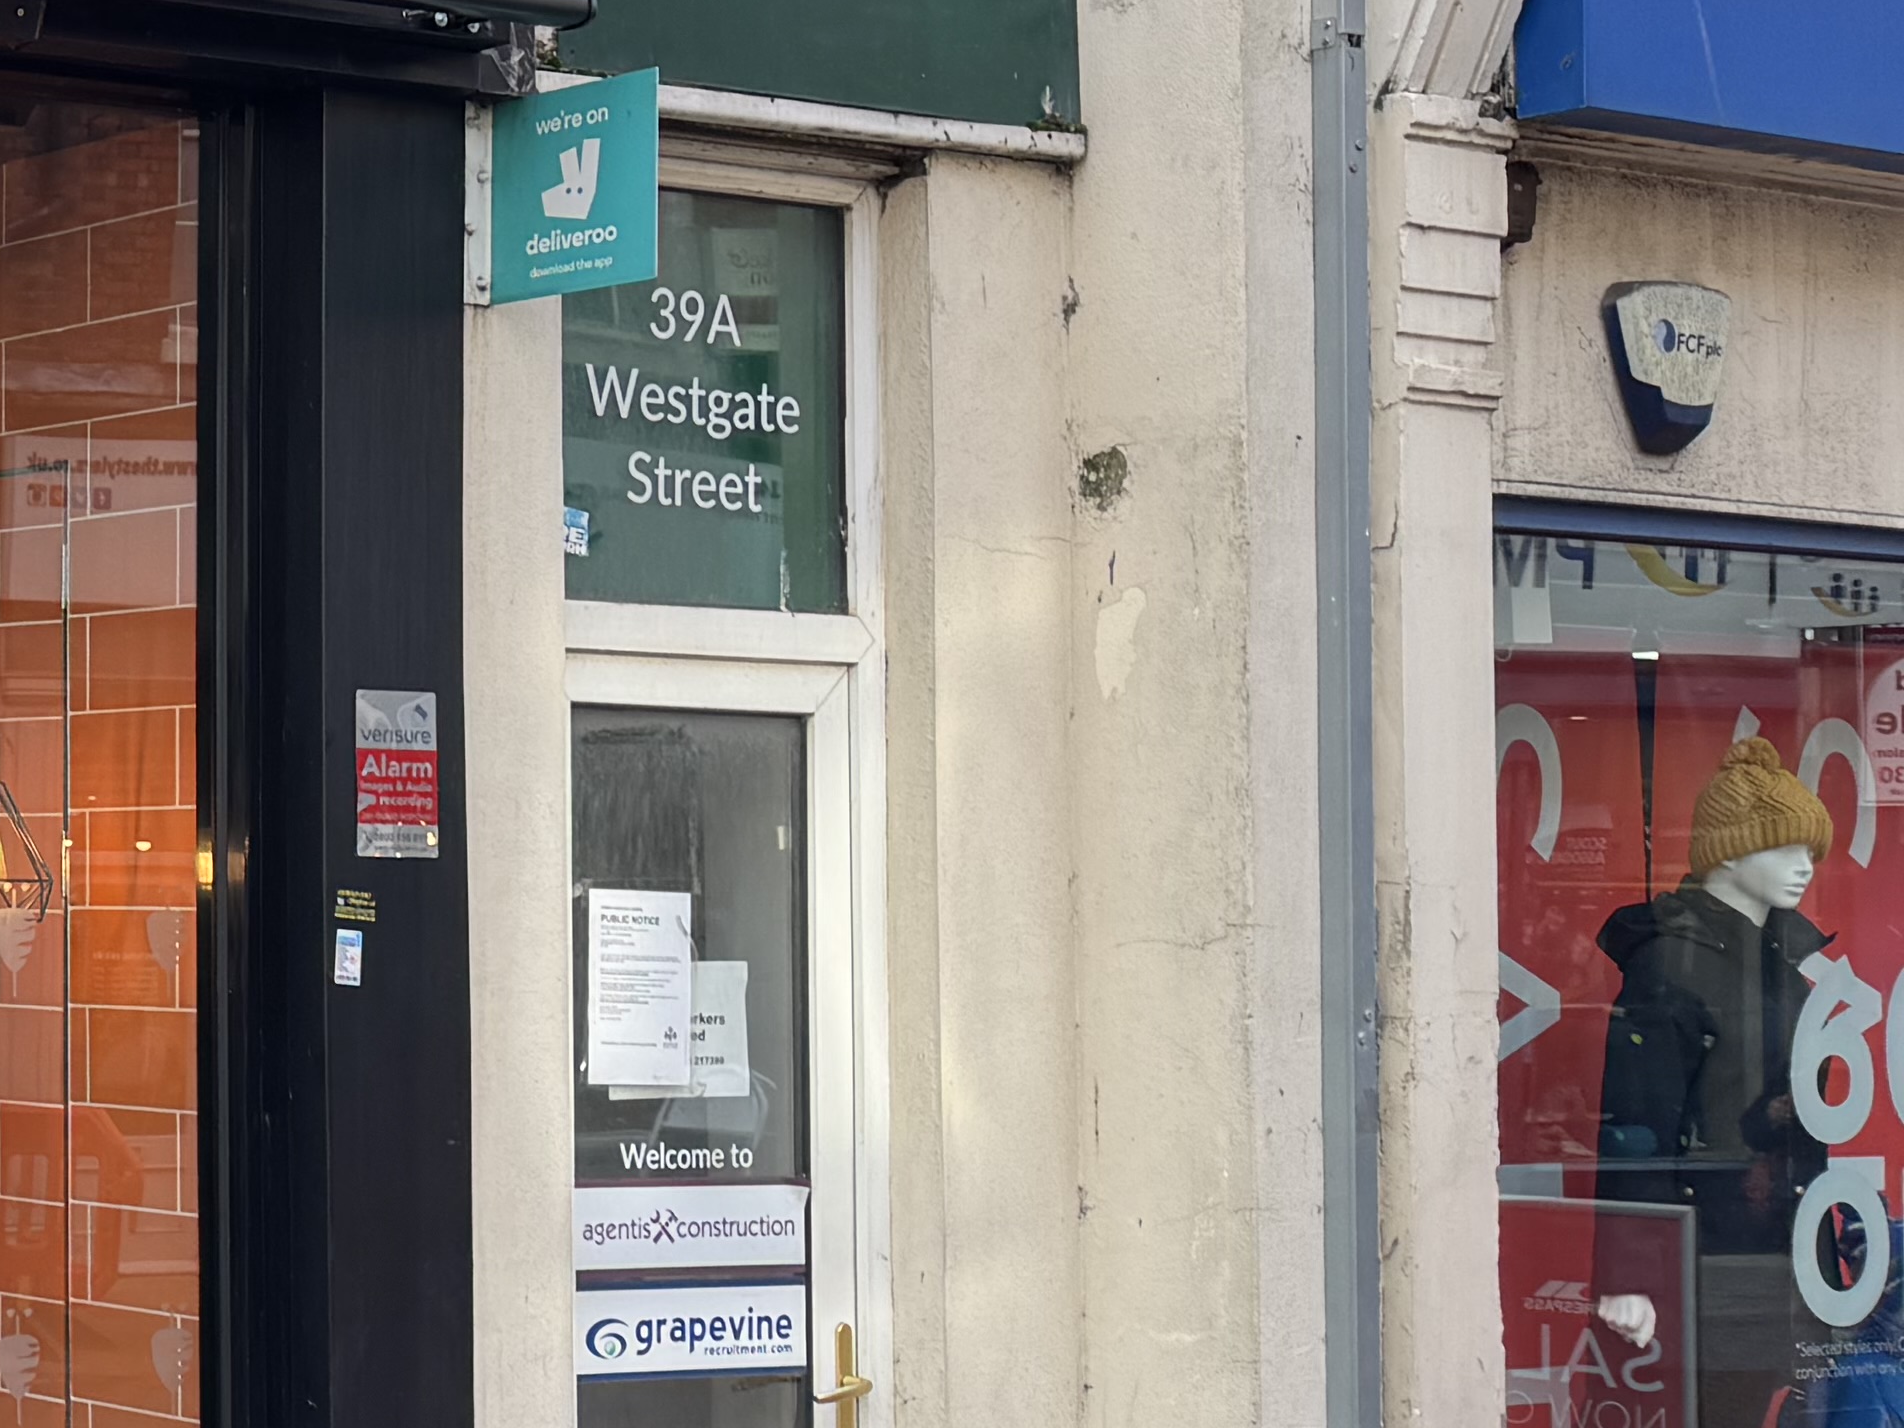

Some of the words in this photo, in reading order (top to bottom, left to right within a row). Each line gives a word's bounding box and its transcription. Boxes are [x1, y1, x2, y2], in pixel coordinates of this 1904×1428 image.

[536, 110, 583, 135] we're
[586, 107, 608, 125] on
[525, 225, 618, 256] deliveroo
[529, 260, 575, 279] download
[576, 257, 593, 270] the
[594, 256, 613, 270] app
[650, 287, 741, 347] 39A
[1677, 333, 1705, 355] FCF
[1706, 341, 1722, 359] plc
[585, 363, 800, 439] Westgate
[626, 450, 762, 513] Street
[360, 727, 432, 745] verisure
[361, 754, 433, 778] Alarm
[379, 794, 433, 810] recording
[600, 913, 630, 925] PUBLIC
[631, 915, 660, 927] NOTICE
[620, 1141, 725, 1170] Welcome
[731, 1143, 754, 1169] to
[582, 1217, 651, 1246] agentis
[676, 1215, 796, 1239] construction
[635, 1306, 793, 1356] grapevine
[1852, 1363, 1876, 1377] with
